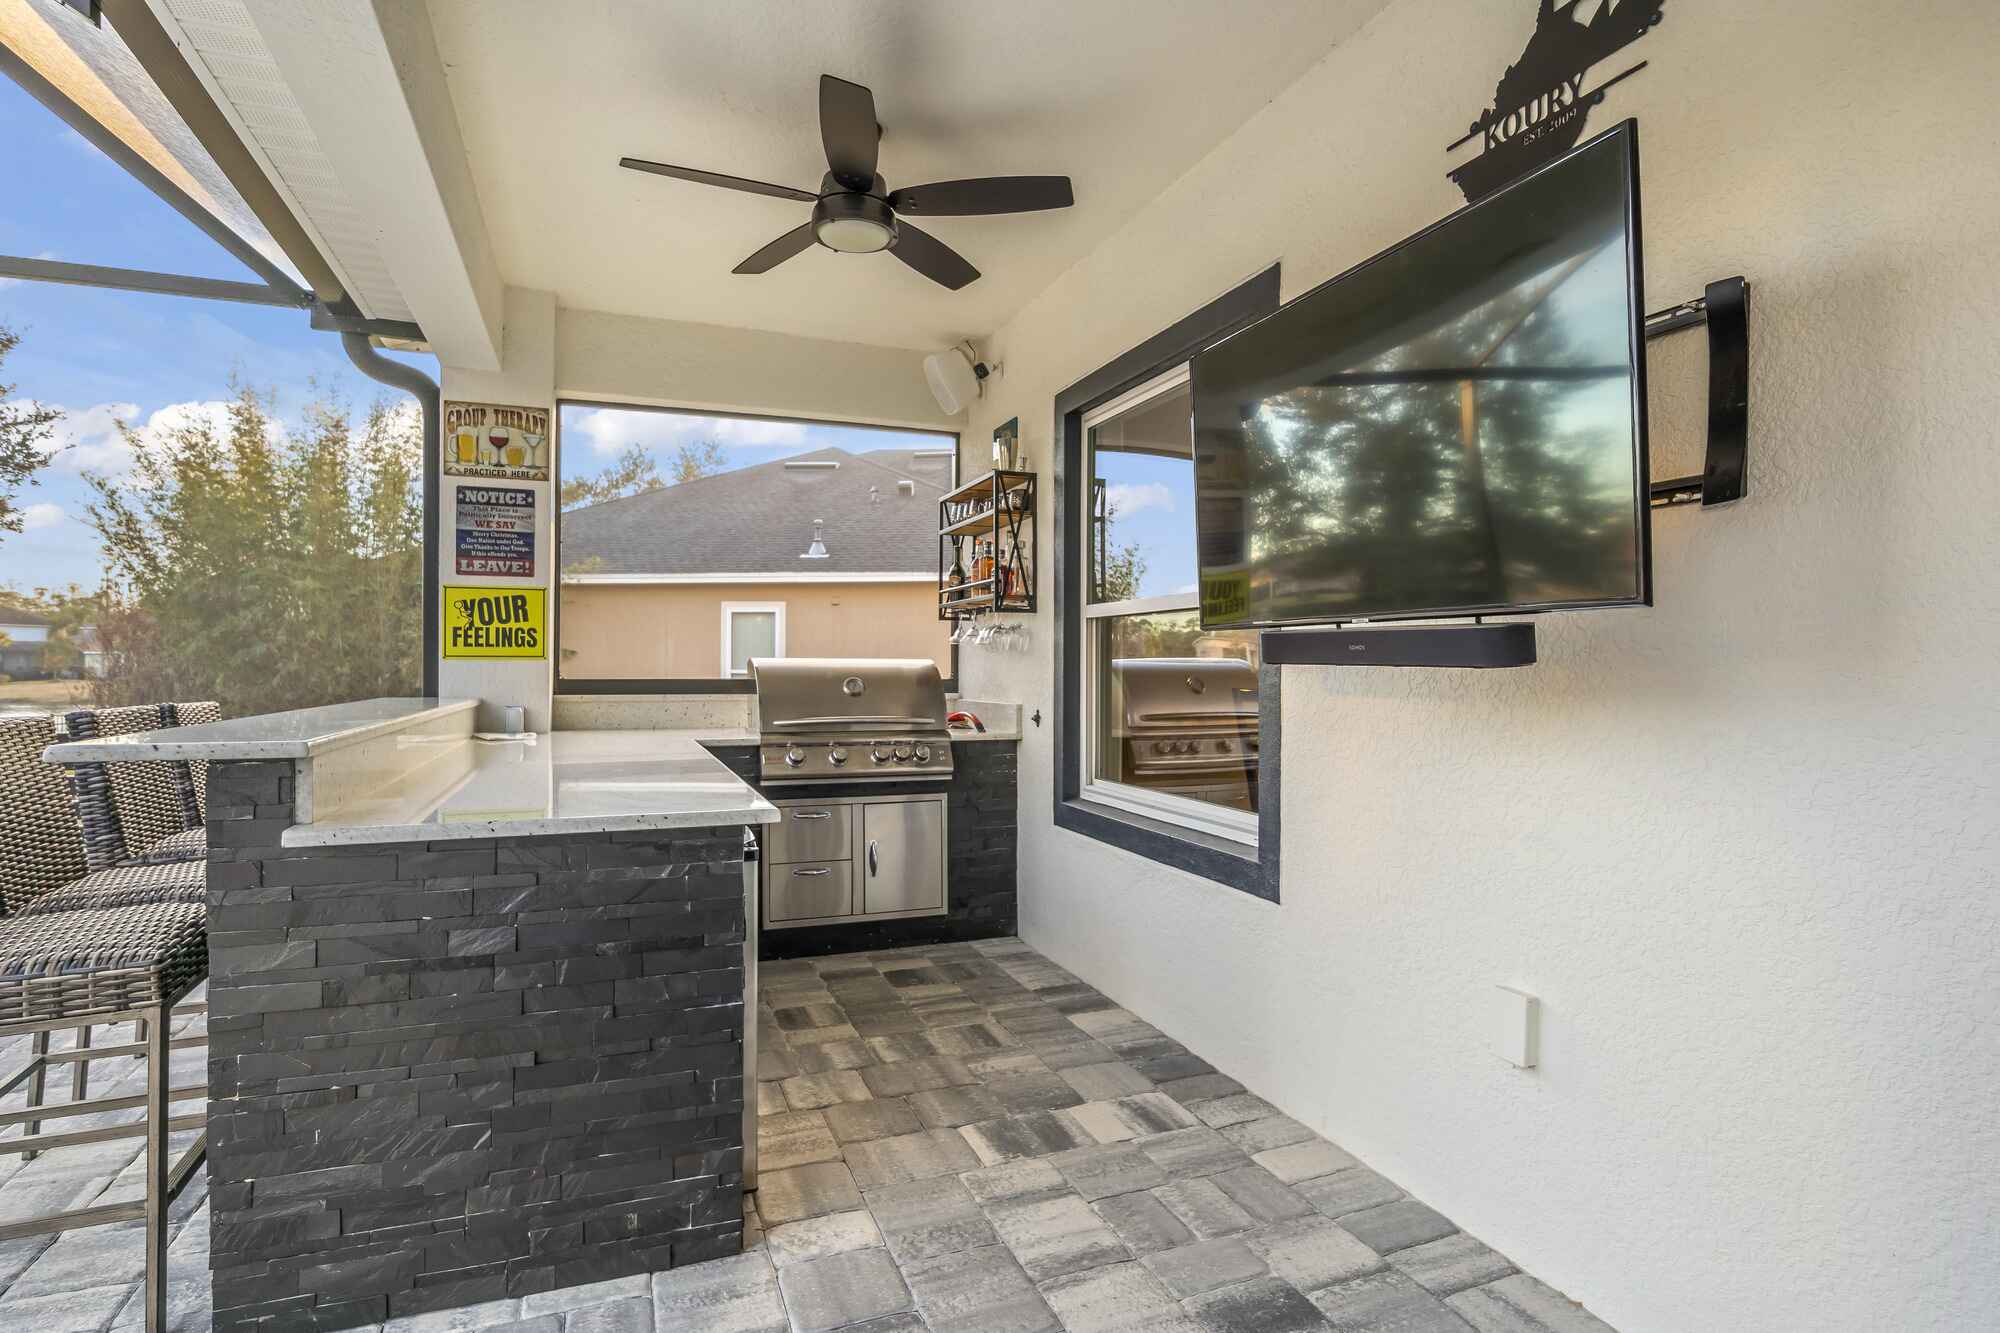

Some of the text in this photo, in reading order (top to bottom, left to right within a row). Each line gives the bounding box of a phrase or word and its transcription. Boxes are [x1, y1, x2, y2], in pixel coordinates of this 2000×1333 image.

[1484, 71, 1583, 150] KOURY
[447, 407, 546, 434] GROUP THERAPY
[463, 467, 531, 479] PRACTICED HERE
[464, 489, 526, 505] NOTICE
[474, 520, 517, 529] WE SAY
[460, 559, 530, 573] LEAVE!
[461, 594, 529, 630] YOUR
[452, 626, 538, 648] FEELINGS
